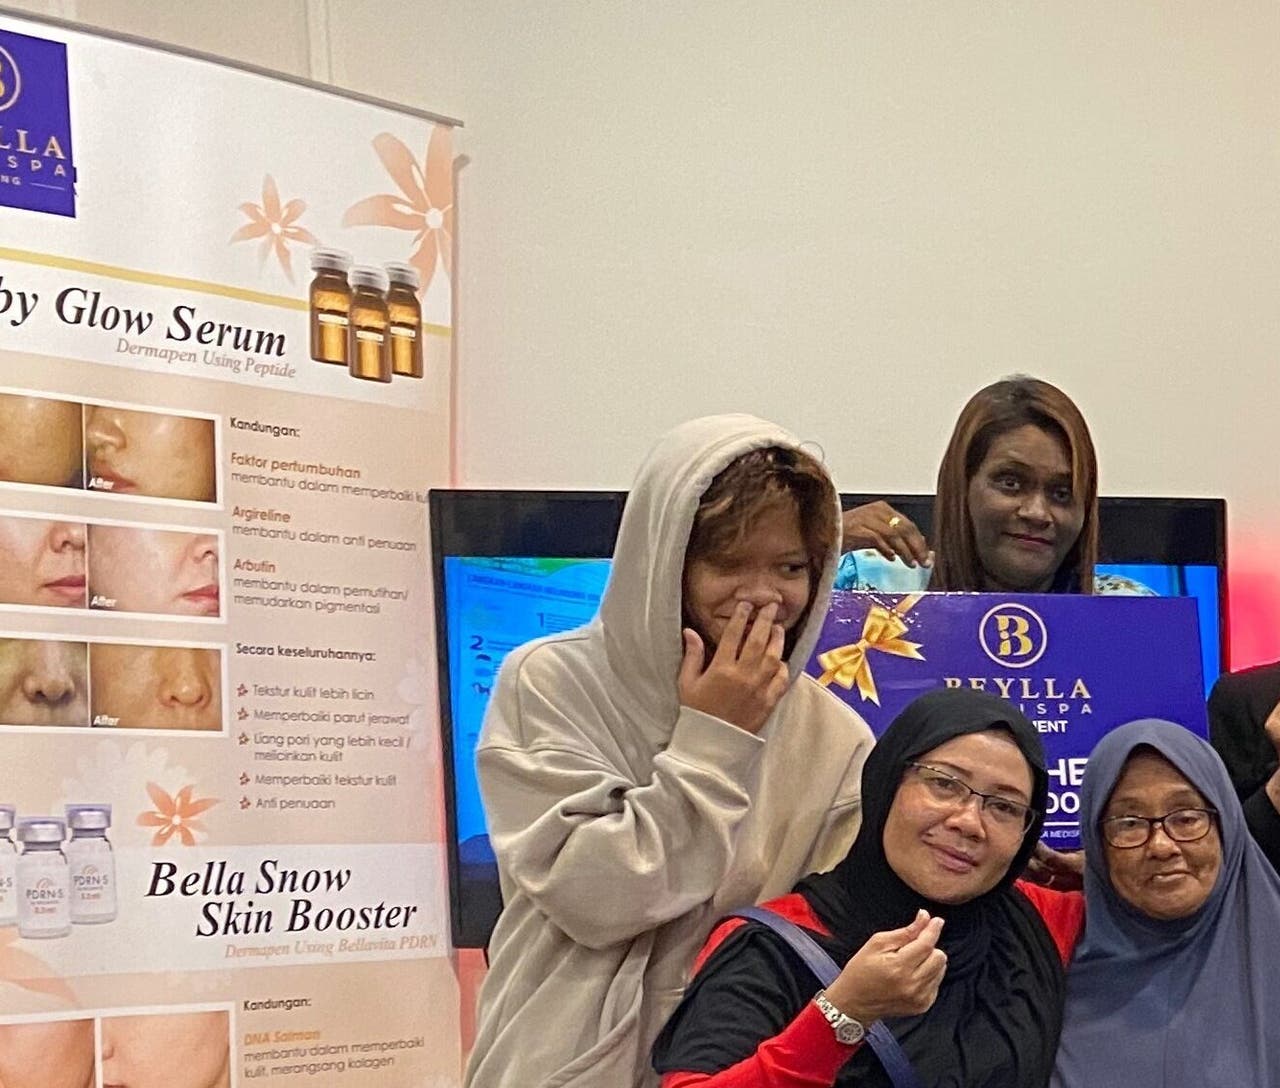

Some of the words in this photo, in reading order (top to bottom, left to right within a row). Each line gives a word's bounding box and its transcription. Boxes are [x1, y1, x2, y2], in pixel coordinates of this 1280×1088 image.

[55, 287, 154, 336] Glow
[166, 305, 287, 357] Serum
[116, 338, 198, 364] Dermapen
[202, 350, 242, 374] Using
[244, 357, 297, 379] Peptide
[230, 417, 300, 437] Kandungan:
[231, 453, 268, 469] Faktor
[271, 459, 360, 479] pertumbuhan
[88, 476, 115, 490] After
[231, 472, 295, 489] membantu
[299, 480, 339, 493] dalam
[232, 506, 291, 523] Argireline
[232, 525, 296, 541] membantu
[299, 531, 340, 545] dalam
[343, 534, 365, 546] anti
[368, 537, 416, 551] penuaan
[234, 558, 276, 574] Arbutin
[234, 577, 297, 592] membantu
[300, 582, 341, 596] dalam
[234, 594, 312, 609] memudarkan
[315, 600, 381, 615] pigmentasi
[236, 643, 275, 656] Secara
[277, 645, 376, 664] keseluruhannya:
[253, 685, 290, 697] Tekstur
[293, 686, 316, 698] kulit
[320, 688, 349, 700] lebih
[352, 689, 375, 700] licin
[93, 713, 121, 727] After
[333, 714, 365, 725] parut
[367, 714, 410, 726] jerawat
[254, 734, 284, 747] Liang
[314, 737, 345, 749] yang
[347, 735, 376, 747] lebih
[320, 750, 343, 762] kulit
[335, 775, 373, 786] tekstur
[375, 775, 397, 786] kulit
[256, 798, 277, 809] Anti
[280, 799, 336, 810] penuaan
[144, 861, 245, 897] Bella
[255, 859, 352, 894] Snow
[195, 901, 273, 937] Skin
[285, 899, 418, 932] Booster
[225, 942, 290, 959] Dermapen
[399, 935, 437, 949] PDRN
[243, 998, 312, 1012] Kandungan:
[244, 1032, 270, 1046] DNA
[244, 1047, 307, 1061] membantu
[310, 1044, 349, 1057] dalam
[351, 1037, 425, 1053] memperbaiki
[271, 1061, 345, 1076] merangsang
[348, 1057, 395, 1071] kolagen
